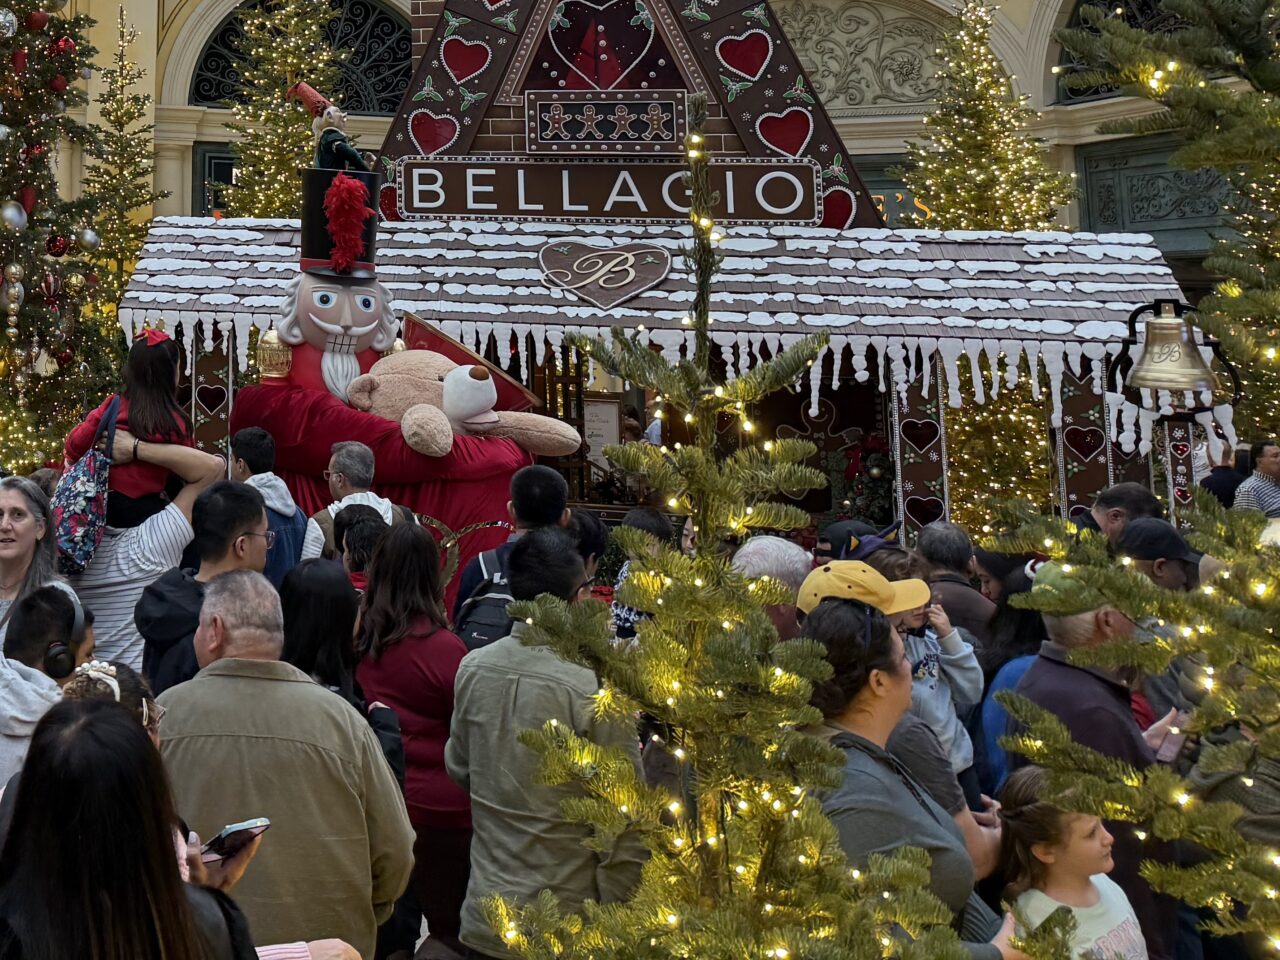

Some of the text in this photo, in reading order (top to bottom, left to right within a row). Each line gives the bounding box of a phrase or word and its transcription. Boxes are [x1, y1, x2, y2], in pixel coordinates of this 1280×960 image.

[412, 168, 805, 214] BELLAGIO
[540, 249, 667, 289] B
[1151, 342, 1182, 364] B
